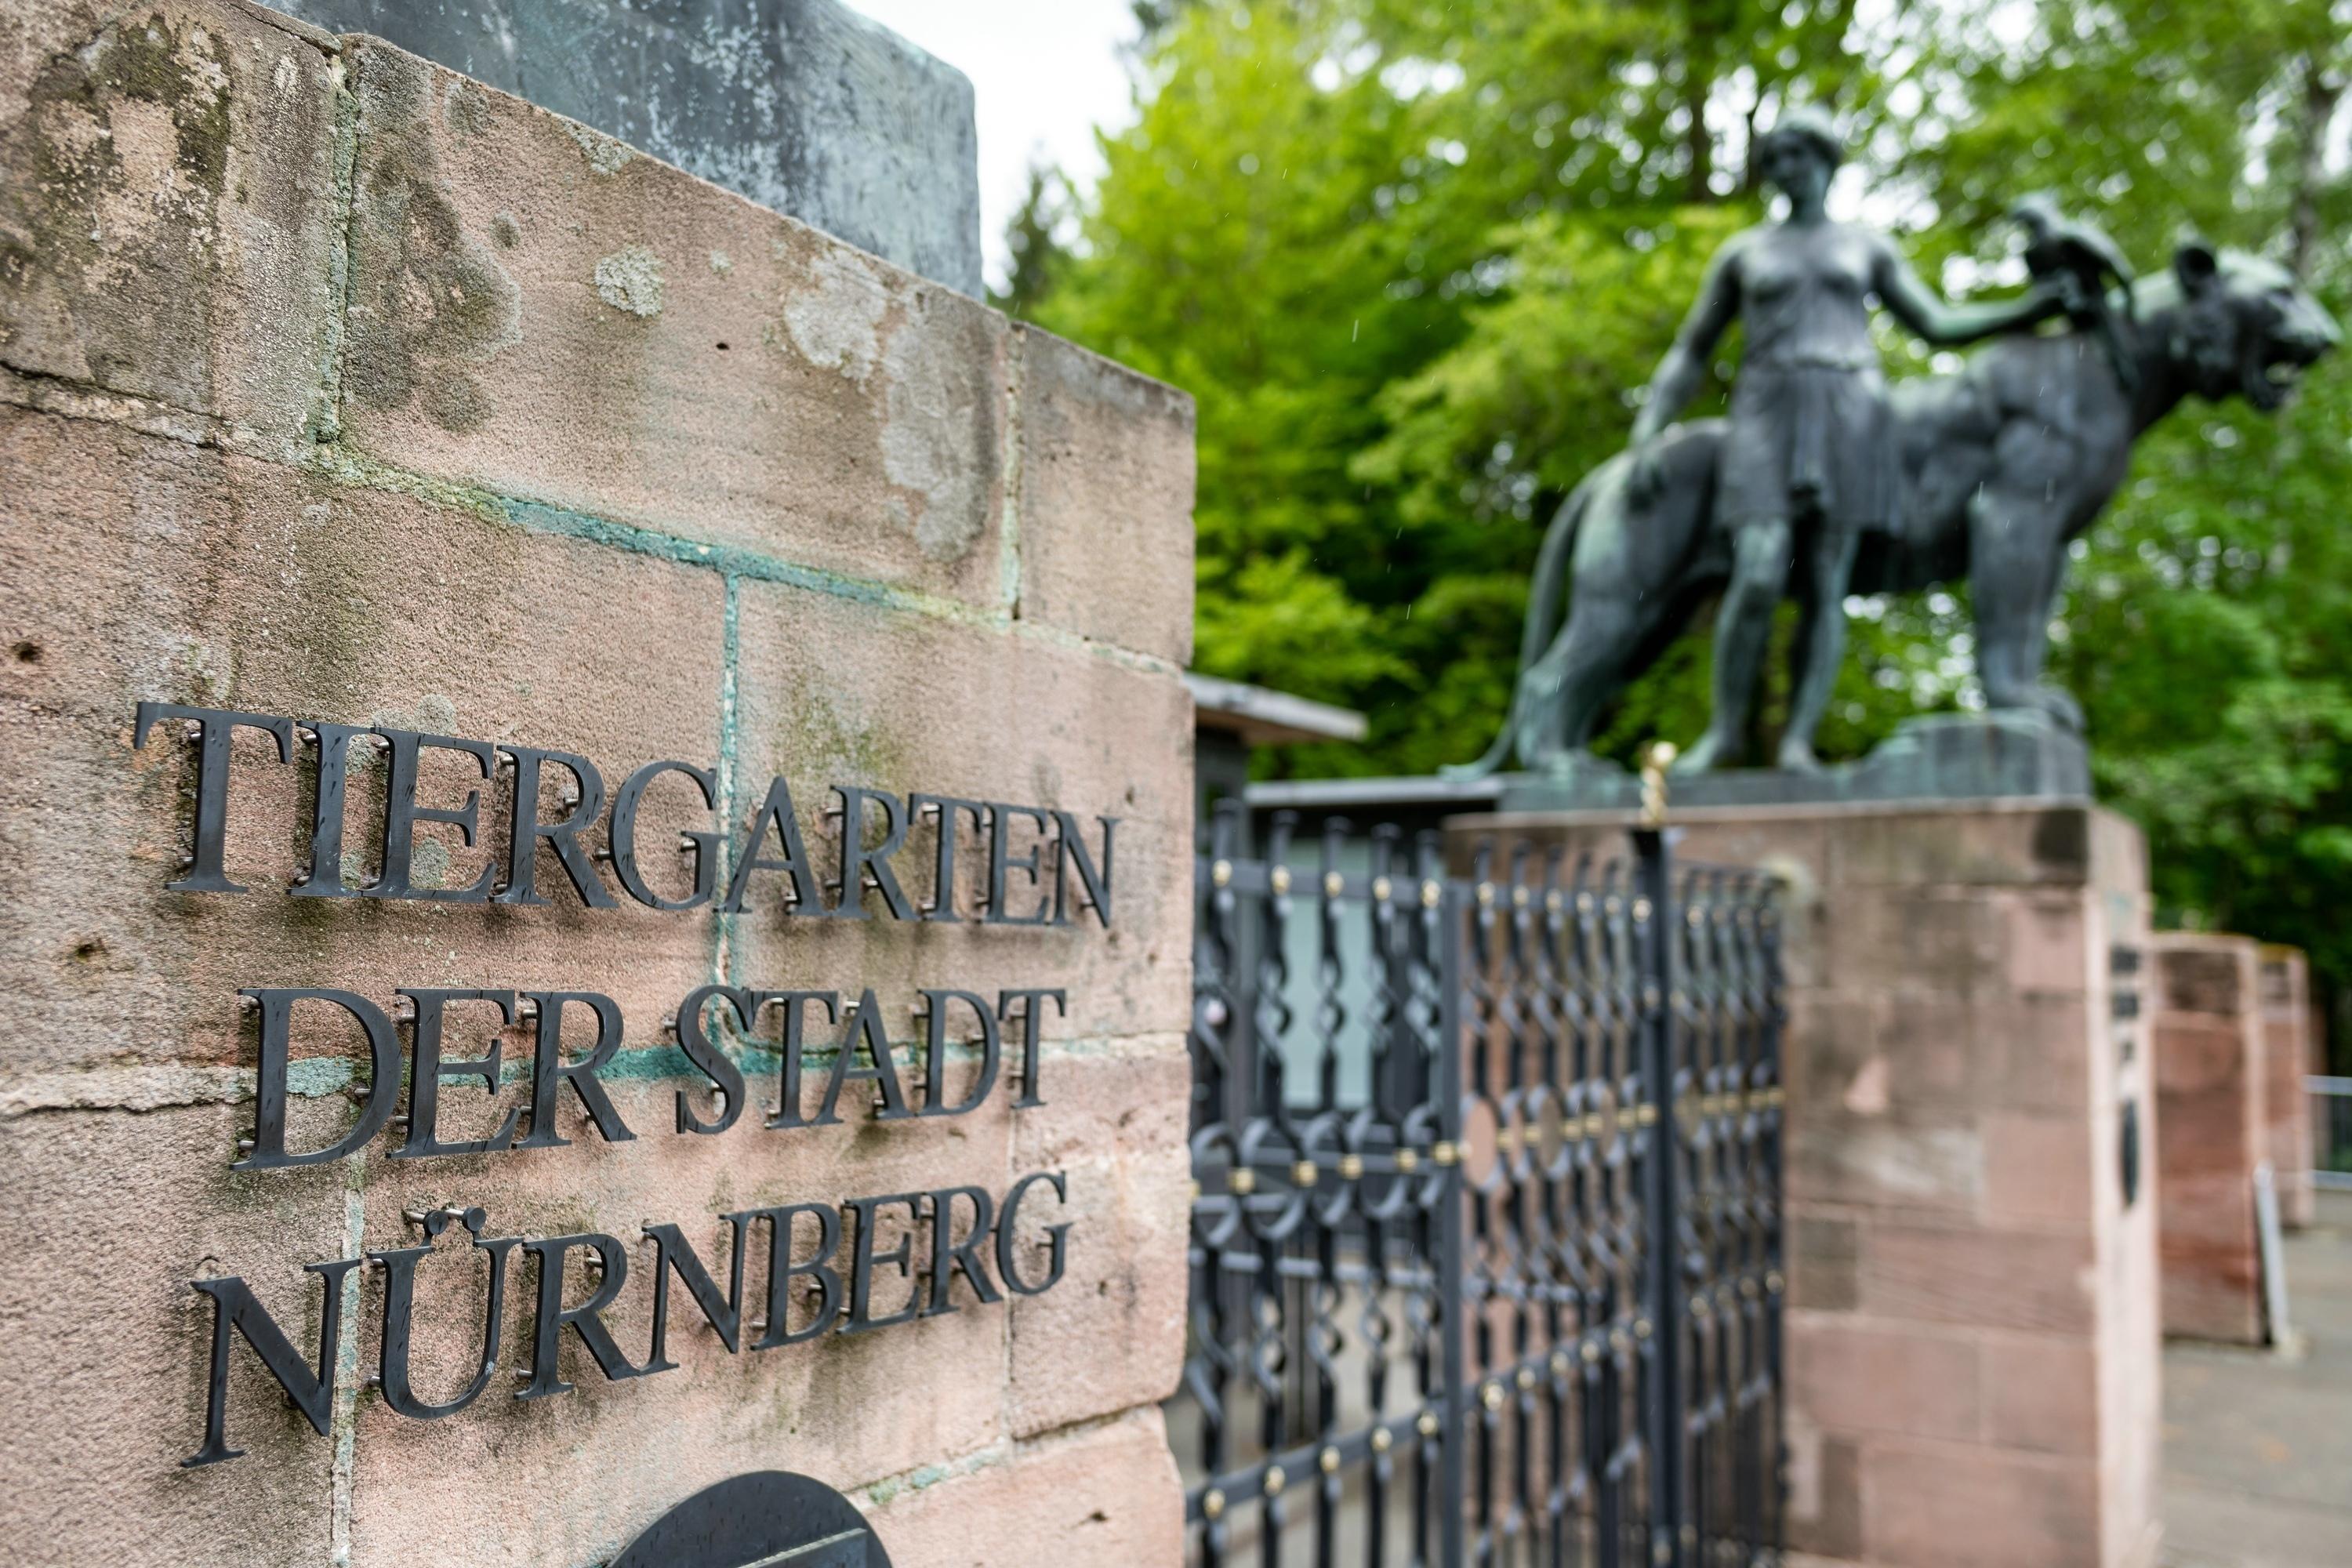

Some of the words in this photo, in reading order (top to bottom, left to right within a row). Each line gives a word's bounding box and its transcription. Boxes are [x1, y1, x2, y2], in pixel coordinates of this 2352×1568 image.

[133, 701, 1122, 928] TIERGARTEN
[229, 988, 637, 1170] DER
[675, 984, 1065, 1134] STADT
[180, 1170, 1073, 1468] NÜRNBERG
